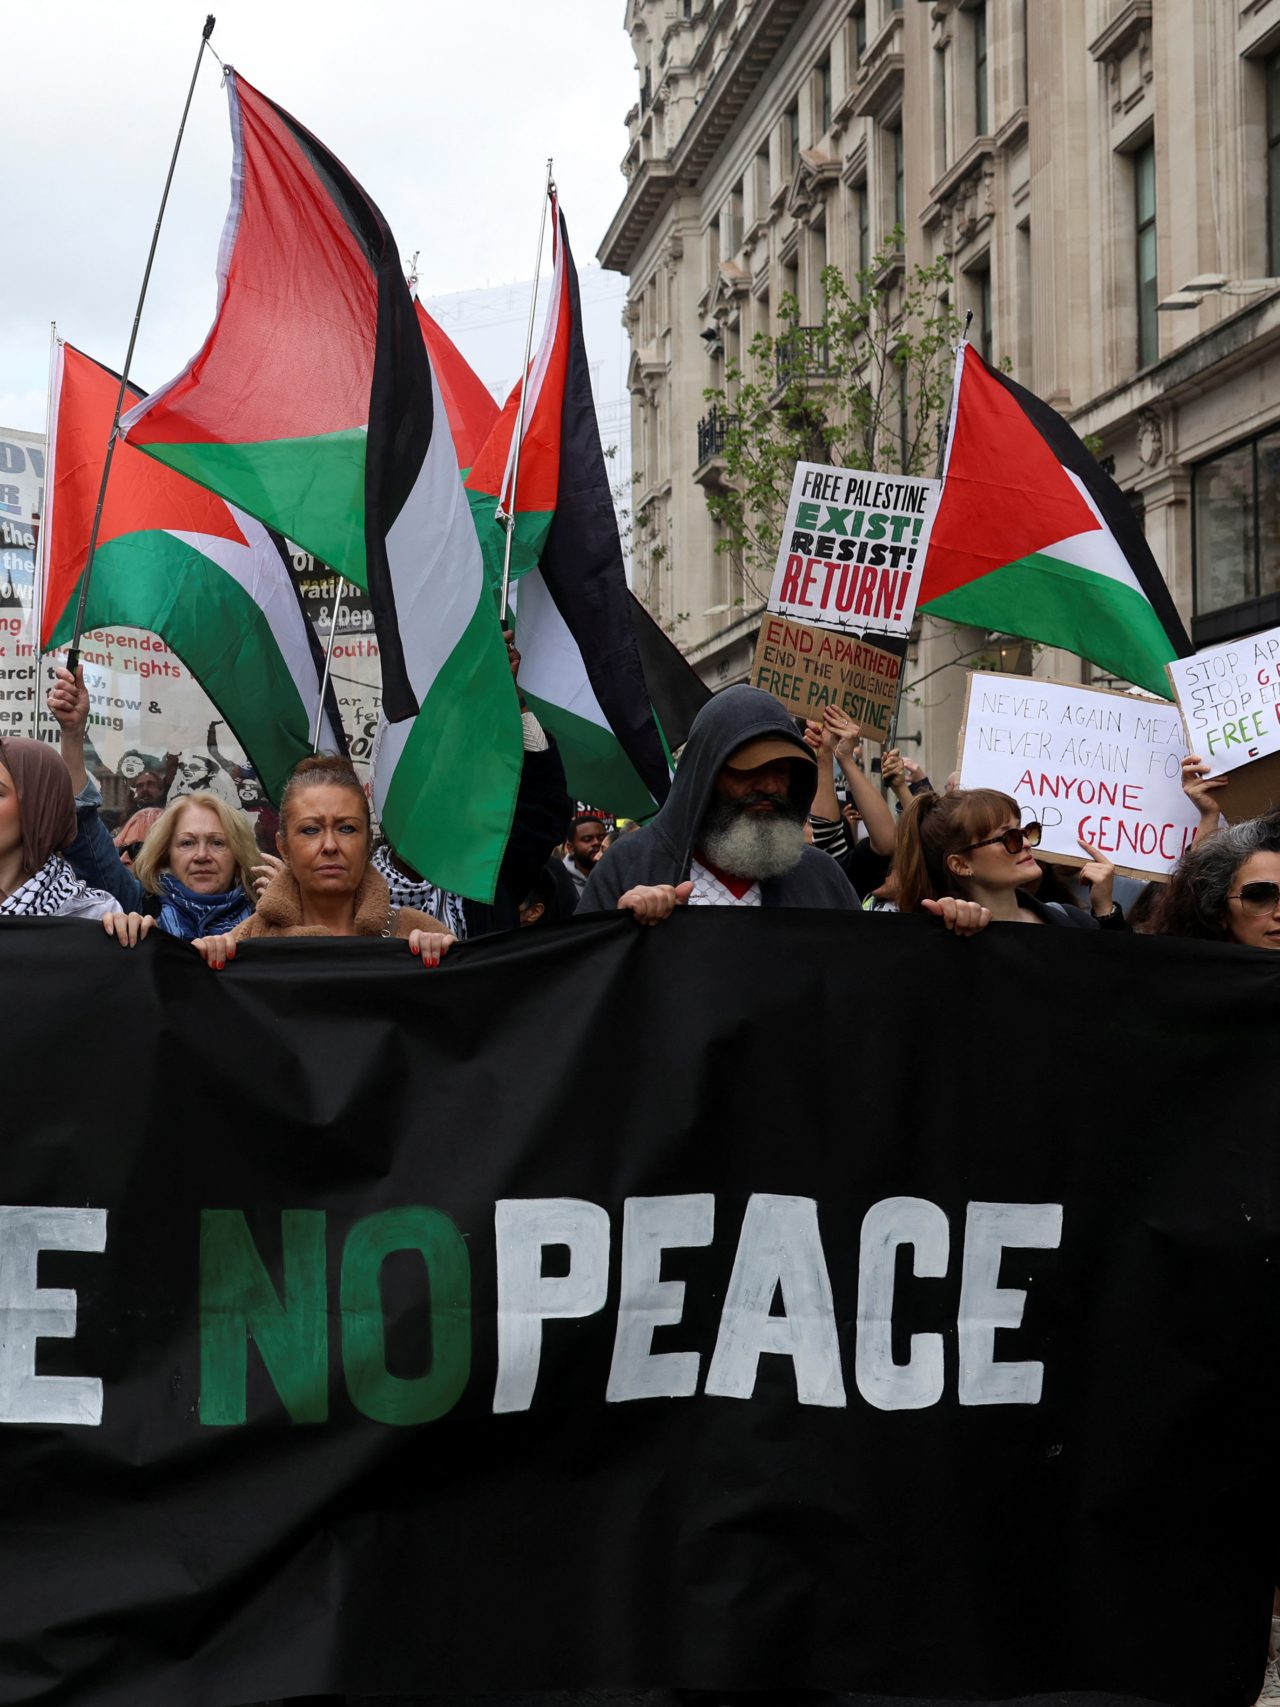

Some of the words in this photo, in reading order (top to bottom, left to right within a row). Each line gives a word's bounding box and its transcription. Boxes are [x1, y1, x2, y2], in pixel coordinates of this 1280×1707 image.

[801, 471, 843, 502] FREE
[844, 478, 930, 514] PALESTINE
[1, 521, 36, 549] the
[795, 502, 924, 545] EXIST!
[3, 551, 35, 573] the
[790, 531, 917, 571] RESIST!
[779, 554, 912, 621] RETURN!
[318, 606, 331, 627] &
[322, 640, 378, 658] outh
[767, 621, 814, 653] END
[123, 656, 181, 678] rights
[764, 646, 796, 668] END
[803, 657, 833, 679] THE
[1185, 652, 1239, 686] STOP
[757, 667, 803, 701] FREE
[1191, 673, 1248, 709] STOP
[148, 701, 162, 714] &
[982, 692, 1049, 720] NEVER
[1060, 705, 1122, 733] AGAIN
[1192, 692, 1252, 729] STOP
[979, 727, 1052, 760] NEVER
[1059, 737, 1130, 773] AGAIN
[1206, 710, 1269, 756] FREE
[1014, 769, 1145, 812] ANYONE
[199, 1207, 472, 1427] NO
[492, 1192, 1064, 1413] PEACE
